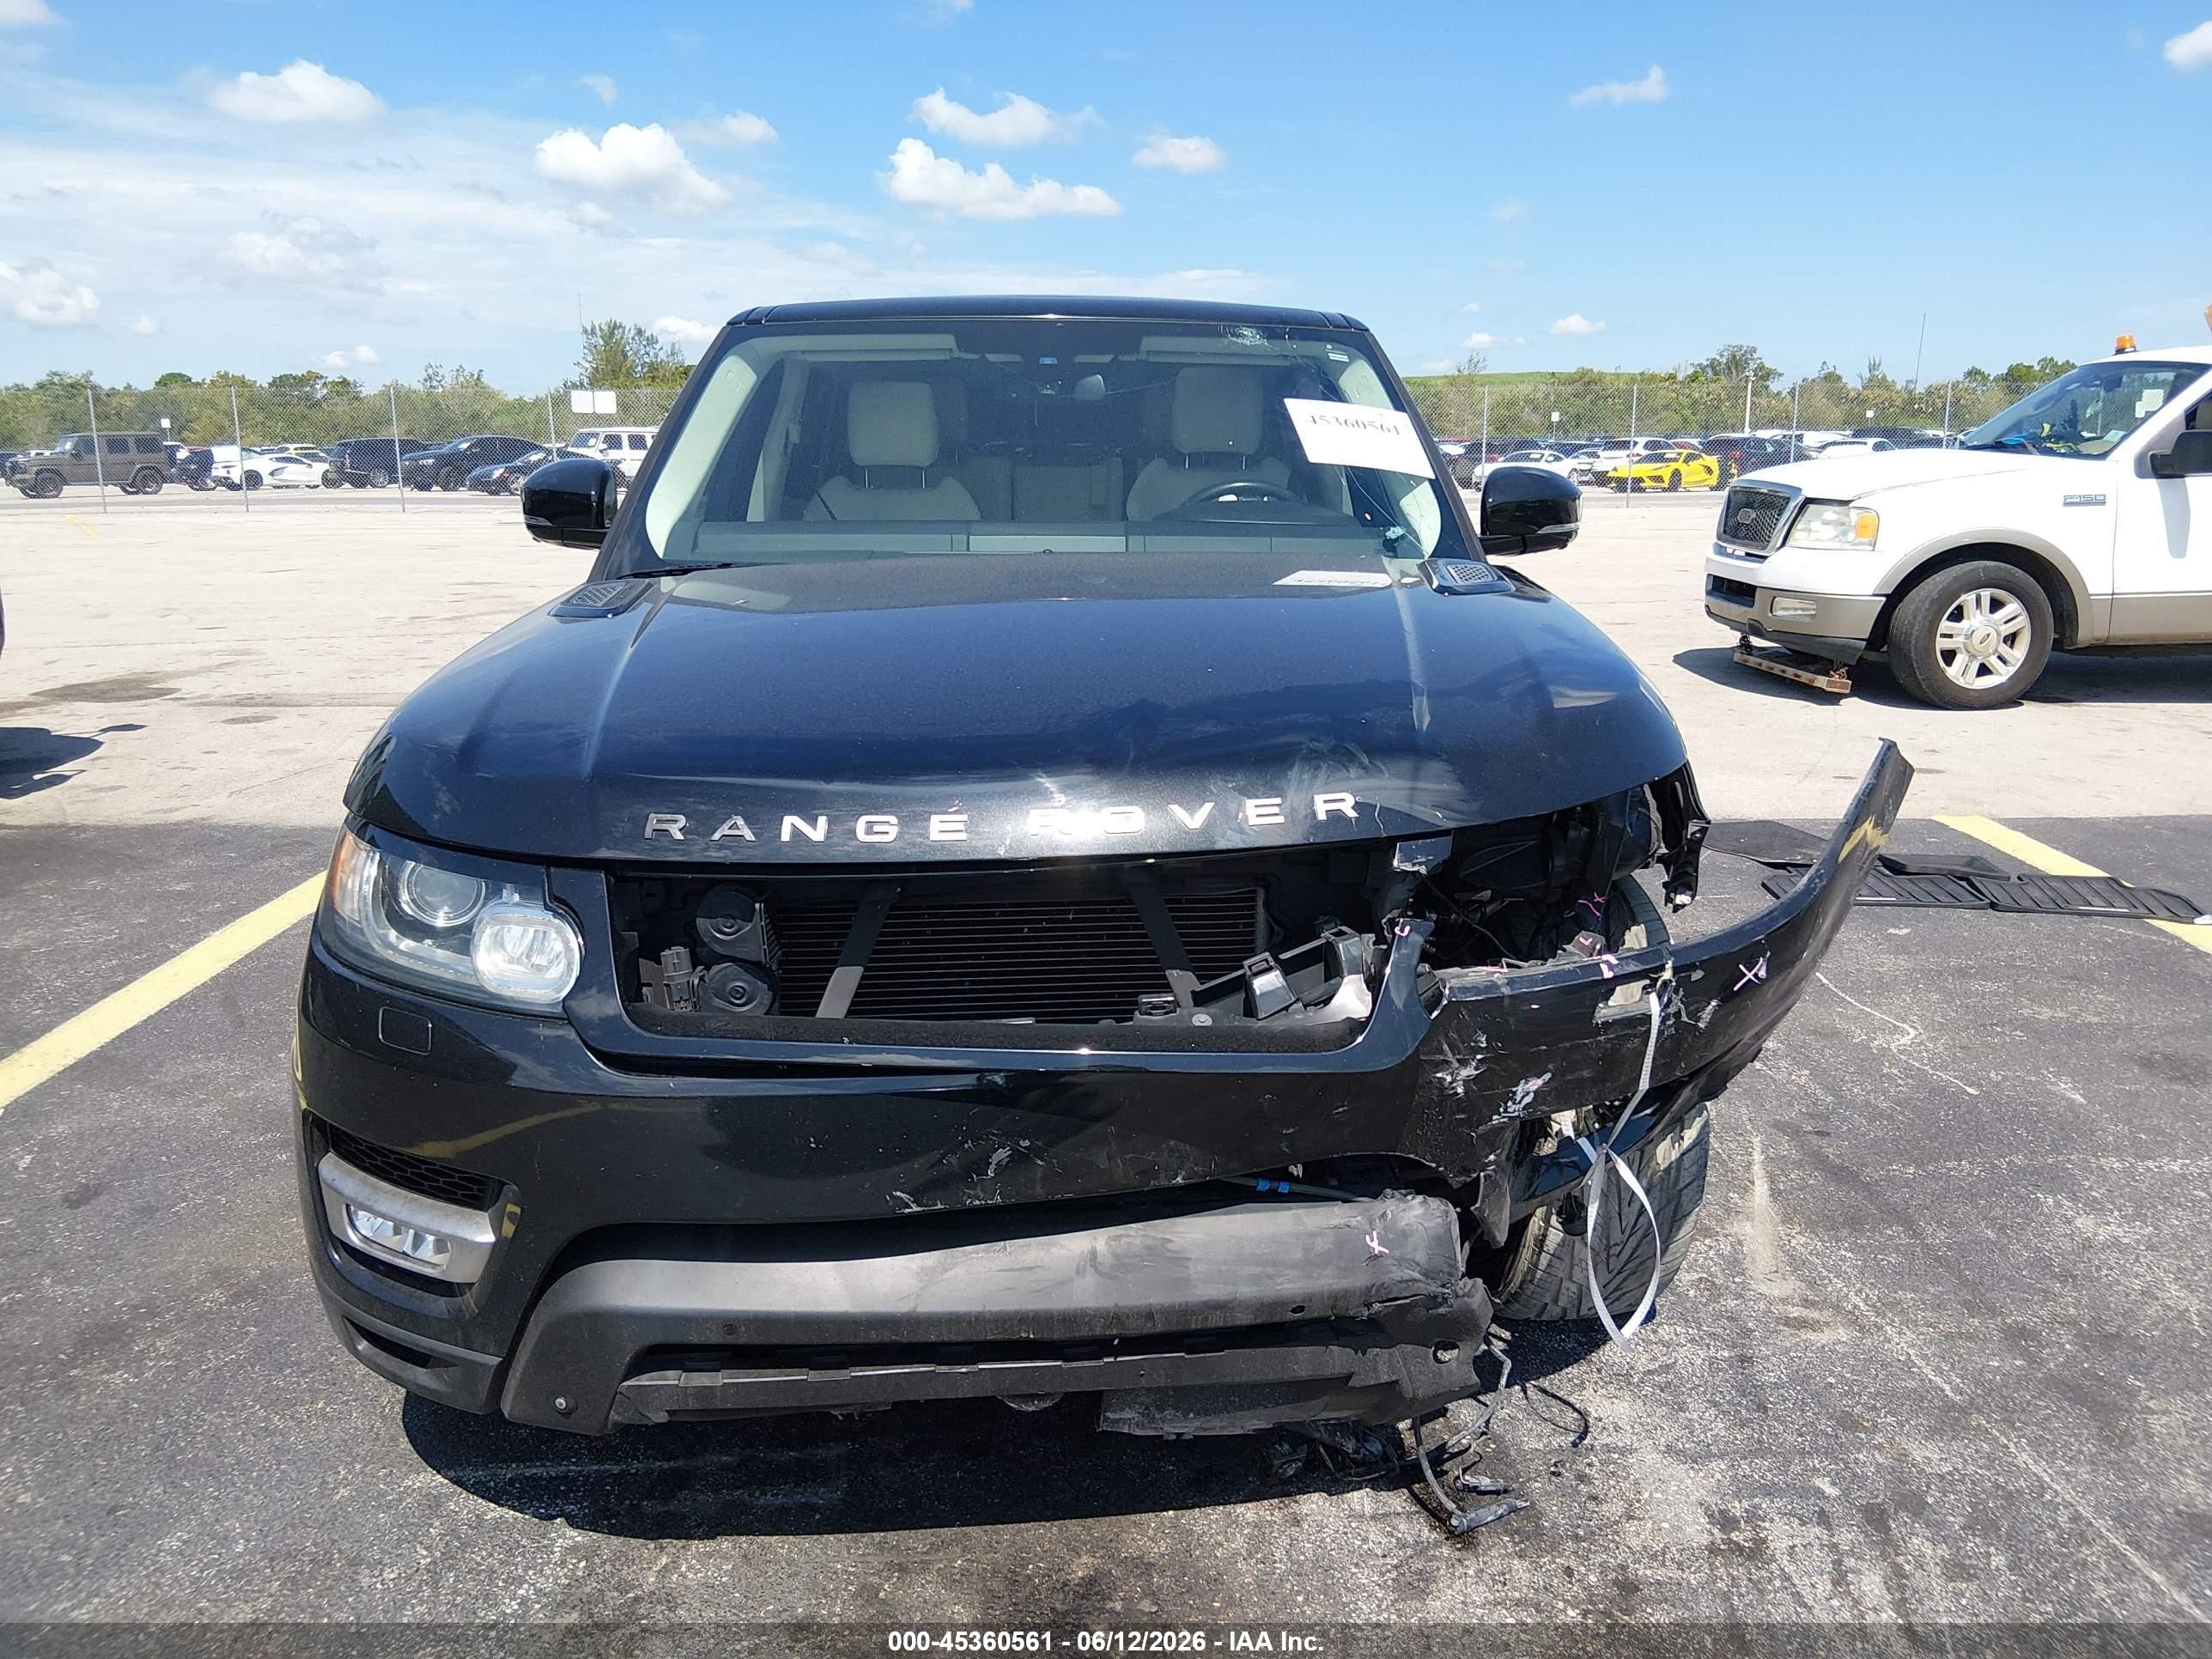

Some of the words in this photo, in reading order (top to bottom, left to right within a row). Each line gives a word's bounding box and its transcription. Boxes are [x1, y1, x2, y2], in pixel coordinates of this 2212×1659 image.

[2063, 494, 2106, 505] F-150
[644, 812, 969, 843] RANGE
[1030, 792, 1359, 836] ROVER
